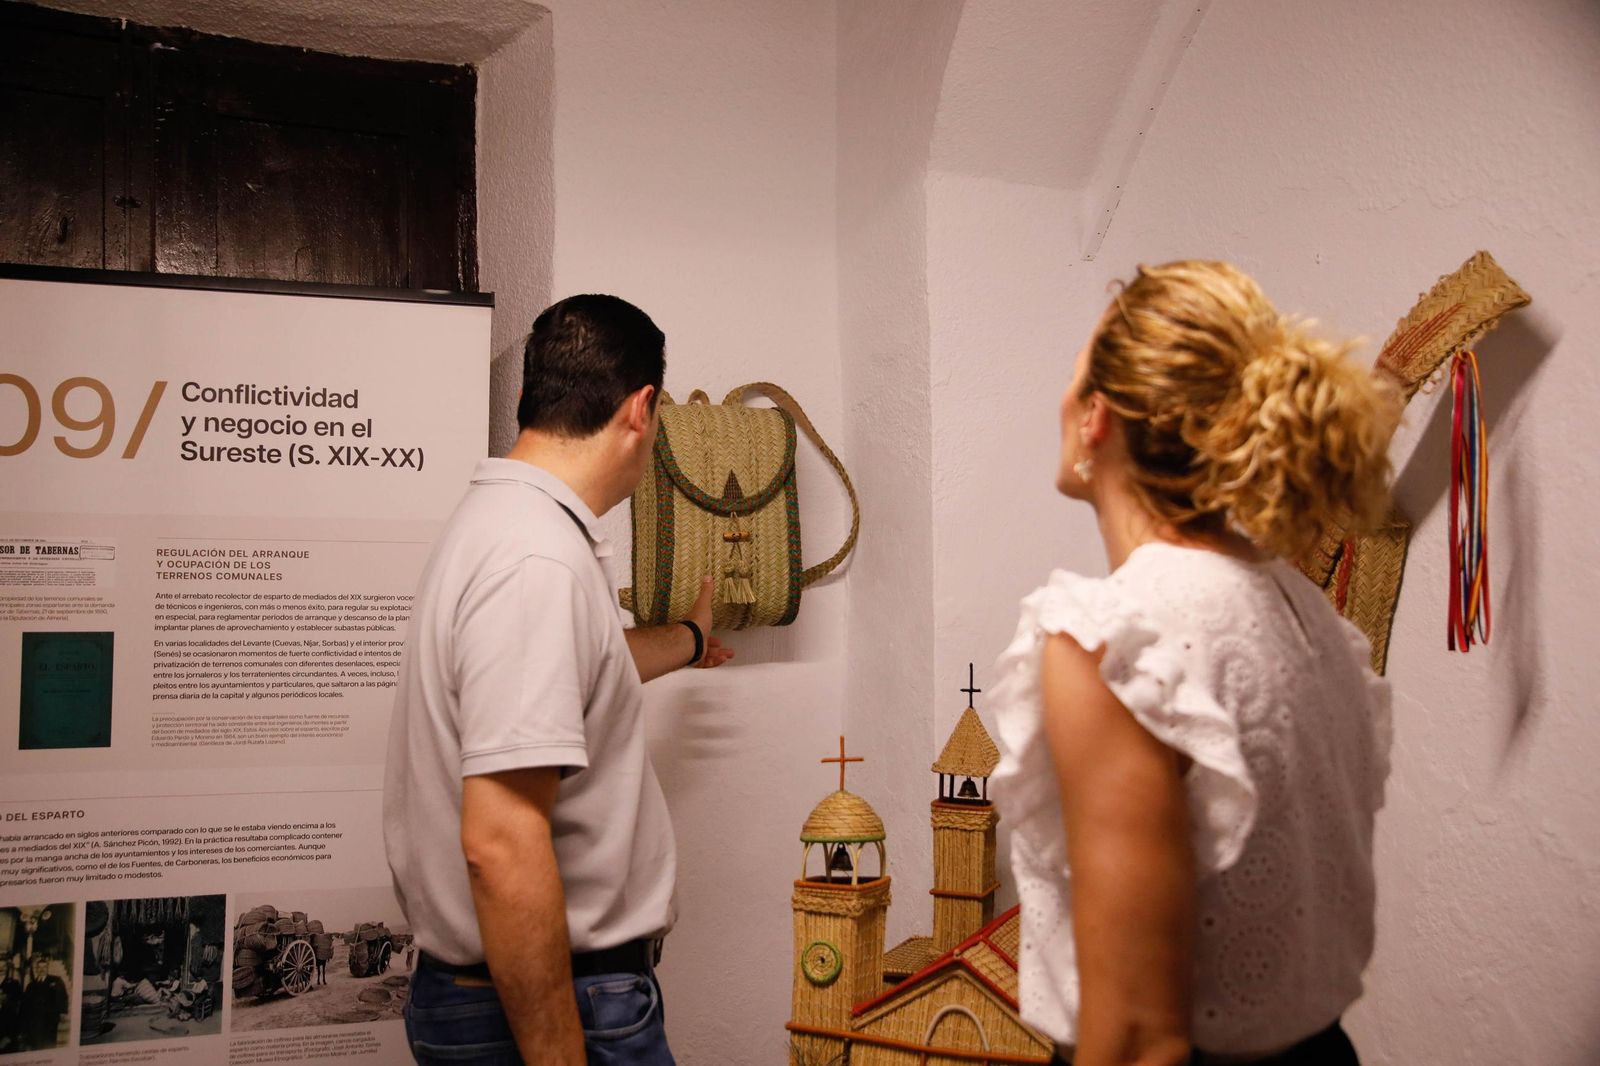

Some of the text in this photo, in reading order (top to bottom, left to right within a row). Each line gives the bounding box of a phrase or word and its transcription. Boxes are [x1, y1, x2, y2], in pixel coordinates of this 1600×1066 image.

[182, 382, 358, 408] Conflictividad
[181, 415, 371, 439] y negocio en el
[181, 438, 423, 471] Sureste (S. XIX-XX)
[20, 546, 30, 554] DE
[36, 546, 79, 555] TABERNAS
[157, 548, 225, 558] REGULACIÓN
[167, 560, 230, 569] OCUPACIÓN
[363, 593, 395, 602] surgieron
[204, 603, 243, 611] ingenieros,
[308, 603, 326, 611] éxito,
[345, 603, 369, 612] regular
[217, 613, 260, 622] reglamentar
[154, 624, 189, 632] implantar
[190, 624, 214, 632] planes
[227, 624, 289, 632] aprovechamiento
[322, 639, 348, 647] Sorbas)
[154, 650, 181, 658] (Senés)
[154, 660, 200, 669] privatización
[186, 671, 222, 680] jornaleros
[370, 670, 395, 678] incluso,
[153, 681, 177, 690] pleitos
[211, 681, 264, 690] ayuntamientos
[272, 681, 315, 689] particulares,
[220, 691, 244, 700] capital
[252, 691, 279, 700] algunos
[281, 691, 317, 700] periódicos
[6, 812, 27, 822] DEL
[32, 810, 85, 820] ESPARTO
[140, 827, 183, 837] comparado
[104, 840, 136, 848] Sánchez
[203, 836, 233, 846] práctica
[234, 835, 268, 843] resultaba
[269, 833, 310, 842] complicado
[114, 850, 170, 860] ayuntamientos
[247, 844, 296, 853] comerciantes.
[298, 843, 326, 851] Aunque
[234, 856, 270, 864] beneficios
[271, 854, 314, 862] económicos
[86, 873, 116, 882] limitado
